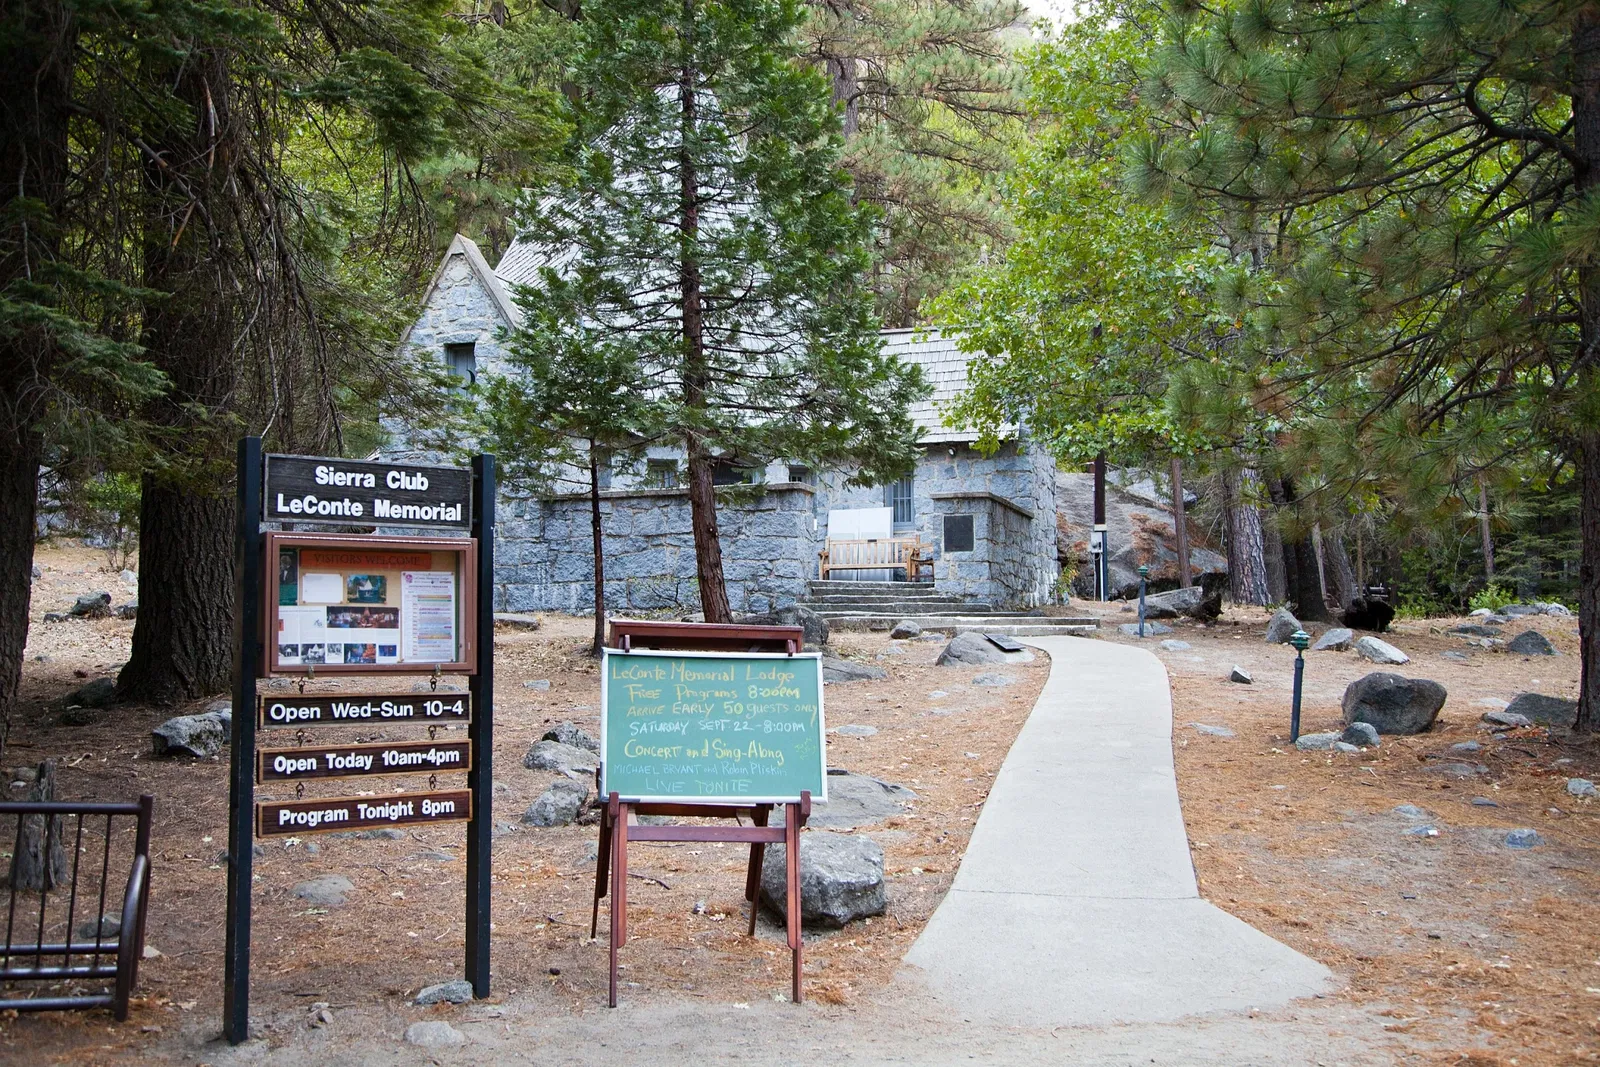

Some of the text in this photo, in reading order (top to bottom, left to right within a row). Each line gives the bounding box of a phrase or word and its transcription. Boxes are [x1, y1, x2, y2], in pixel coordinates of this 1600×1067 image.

[315, 465, 429, 491] Sierra Club
[277, 493, 461, 521] LeConte Memorial
[314, 553, 420, 566] VISITORS WELCOME
[612, 660, 795, 688] LeConte Memorial Lodge
[674, 683, 738, 702] Programs
[270, 700, 463, 722] Open Wed-Sun 10-4
[672, 701, 715, 720] EARLY
[723, 701, 744, 715] 50
[629, 720, 689, 736] SATURDAY
[274, 748, 460, 774] Open Today 10am-4pm
[686, 738, 709, 758] and
[712, 738, 784, 766] Sing-Along
[613, 763, 660, 774] MICHAEL
[662, 763, 701, 775] BRYANT
[646, 778, 752, 794] LIVE TONITE
[279, 799, 455, 827] Program Tonight 8pm
